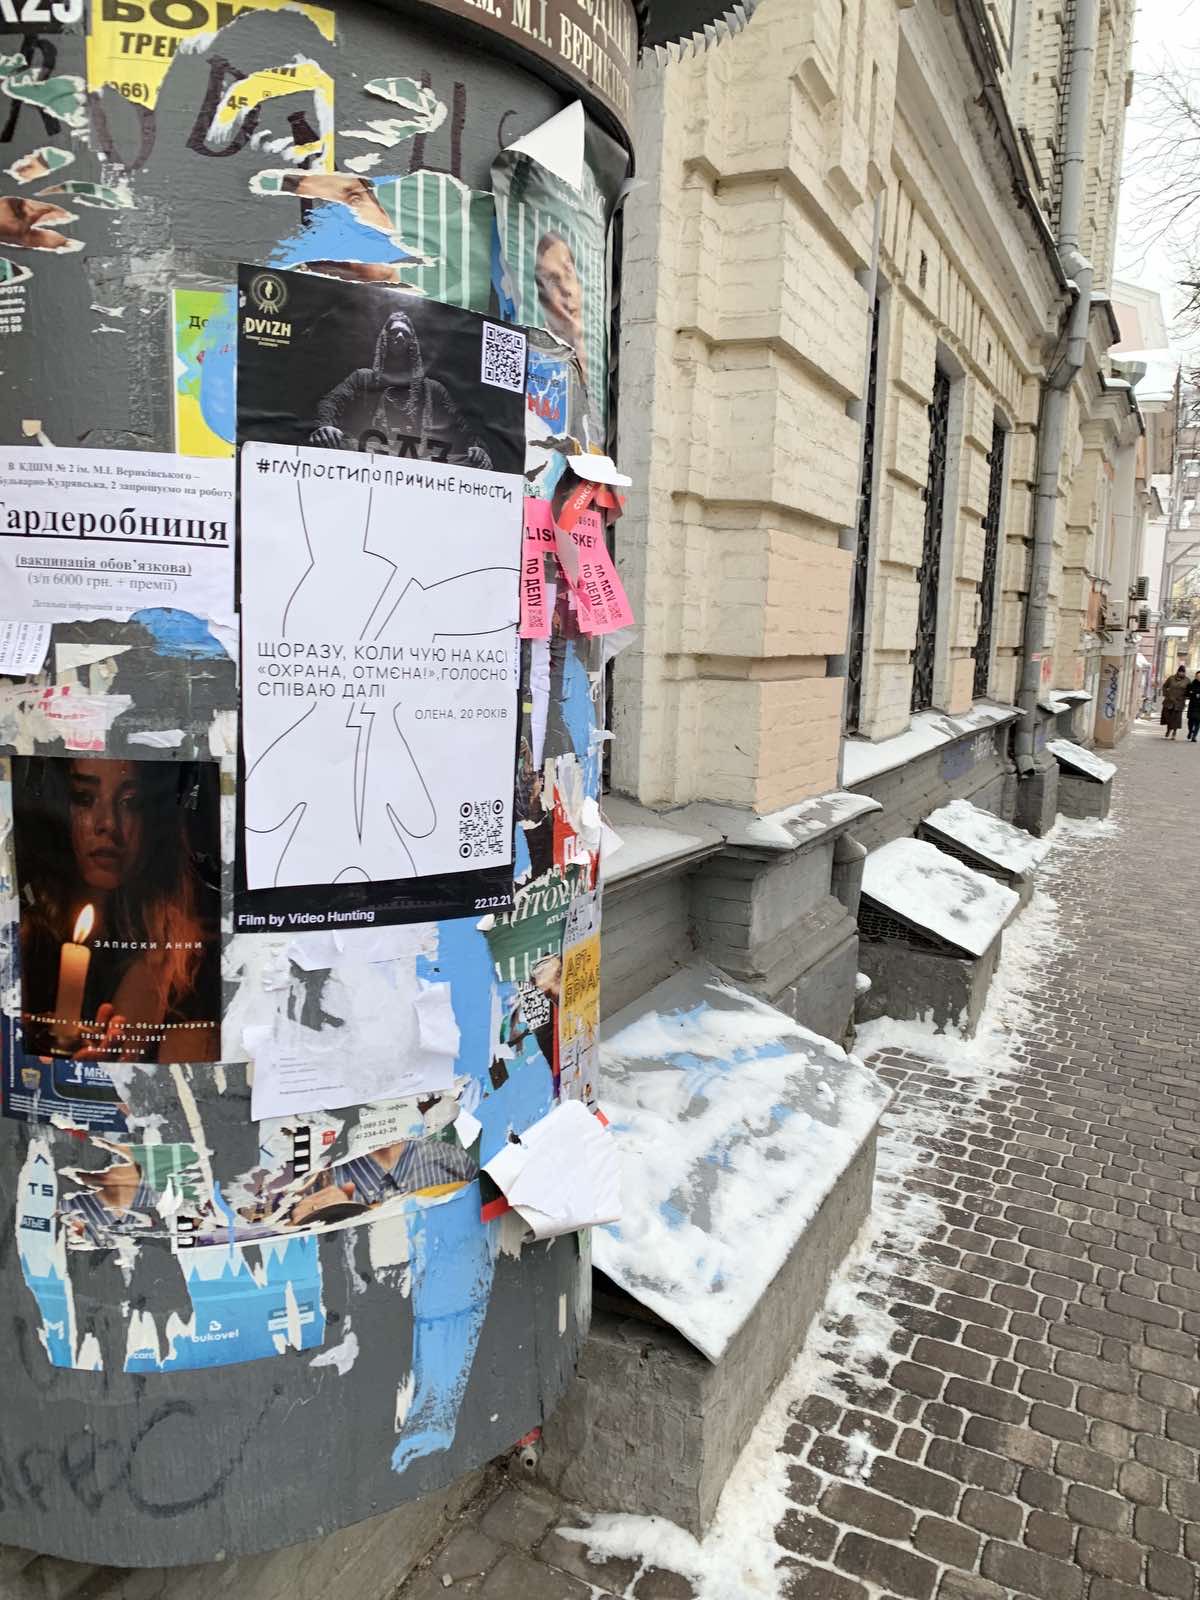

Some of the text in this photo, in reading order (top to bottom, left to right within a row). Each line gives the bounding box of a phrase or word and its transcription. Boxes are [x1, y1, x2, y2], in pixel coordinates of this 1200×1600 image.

[244, 317, 292, 337] DVIZH
[0, 500, 229, 543] ардеробниця
[15, 553, 97, 570] (вакцинація
[53, 573, 83, 586] 6000
[257, 642, 508, 664] ЩОРАЗУ, КОЛИ ЧУЮ НА КАСІ
[257, 664, 346, 681] «ОХРАНА,
[441, 667, 508, 681] ГОЛОСНО
[257, 682, 385, 699] СПІВАЮ ДАЛІ
[414, 708, 508, 721] ОЛЕНА, 20 РОКІВ
[474, 894, 512, 910] 22.12.21
[238, 909, 376, 928] Film by Video Hunting
[94, 940, 203, 950] ЗАПИСКИ АННИ
[191, 1328, 240, 1343] bukovel
